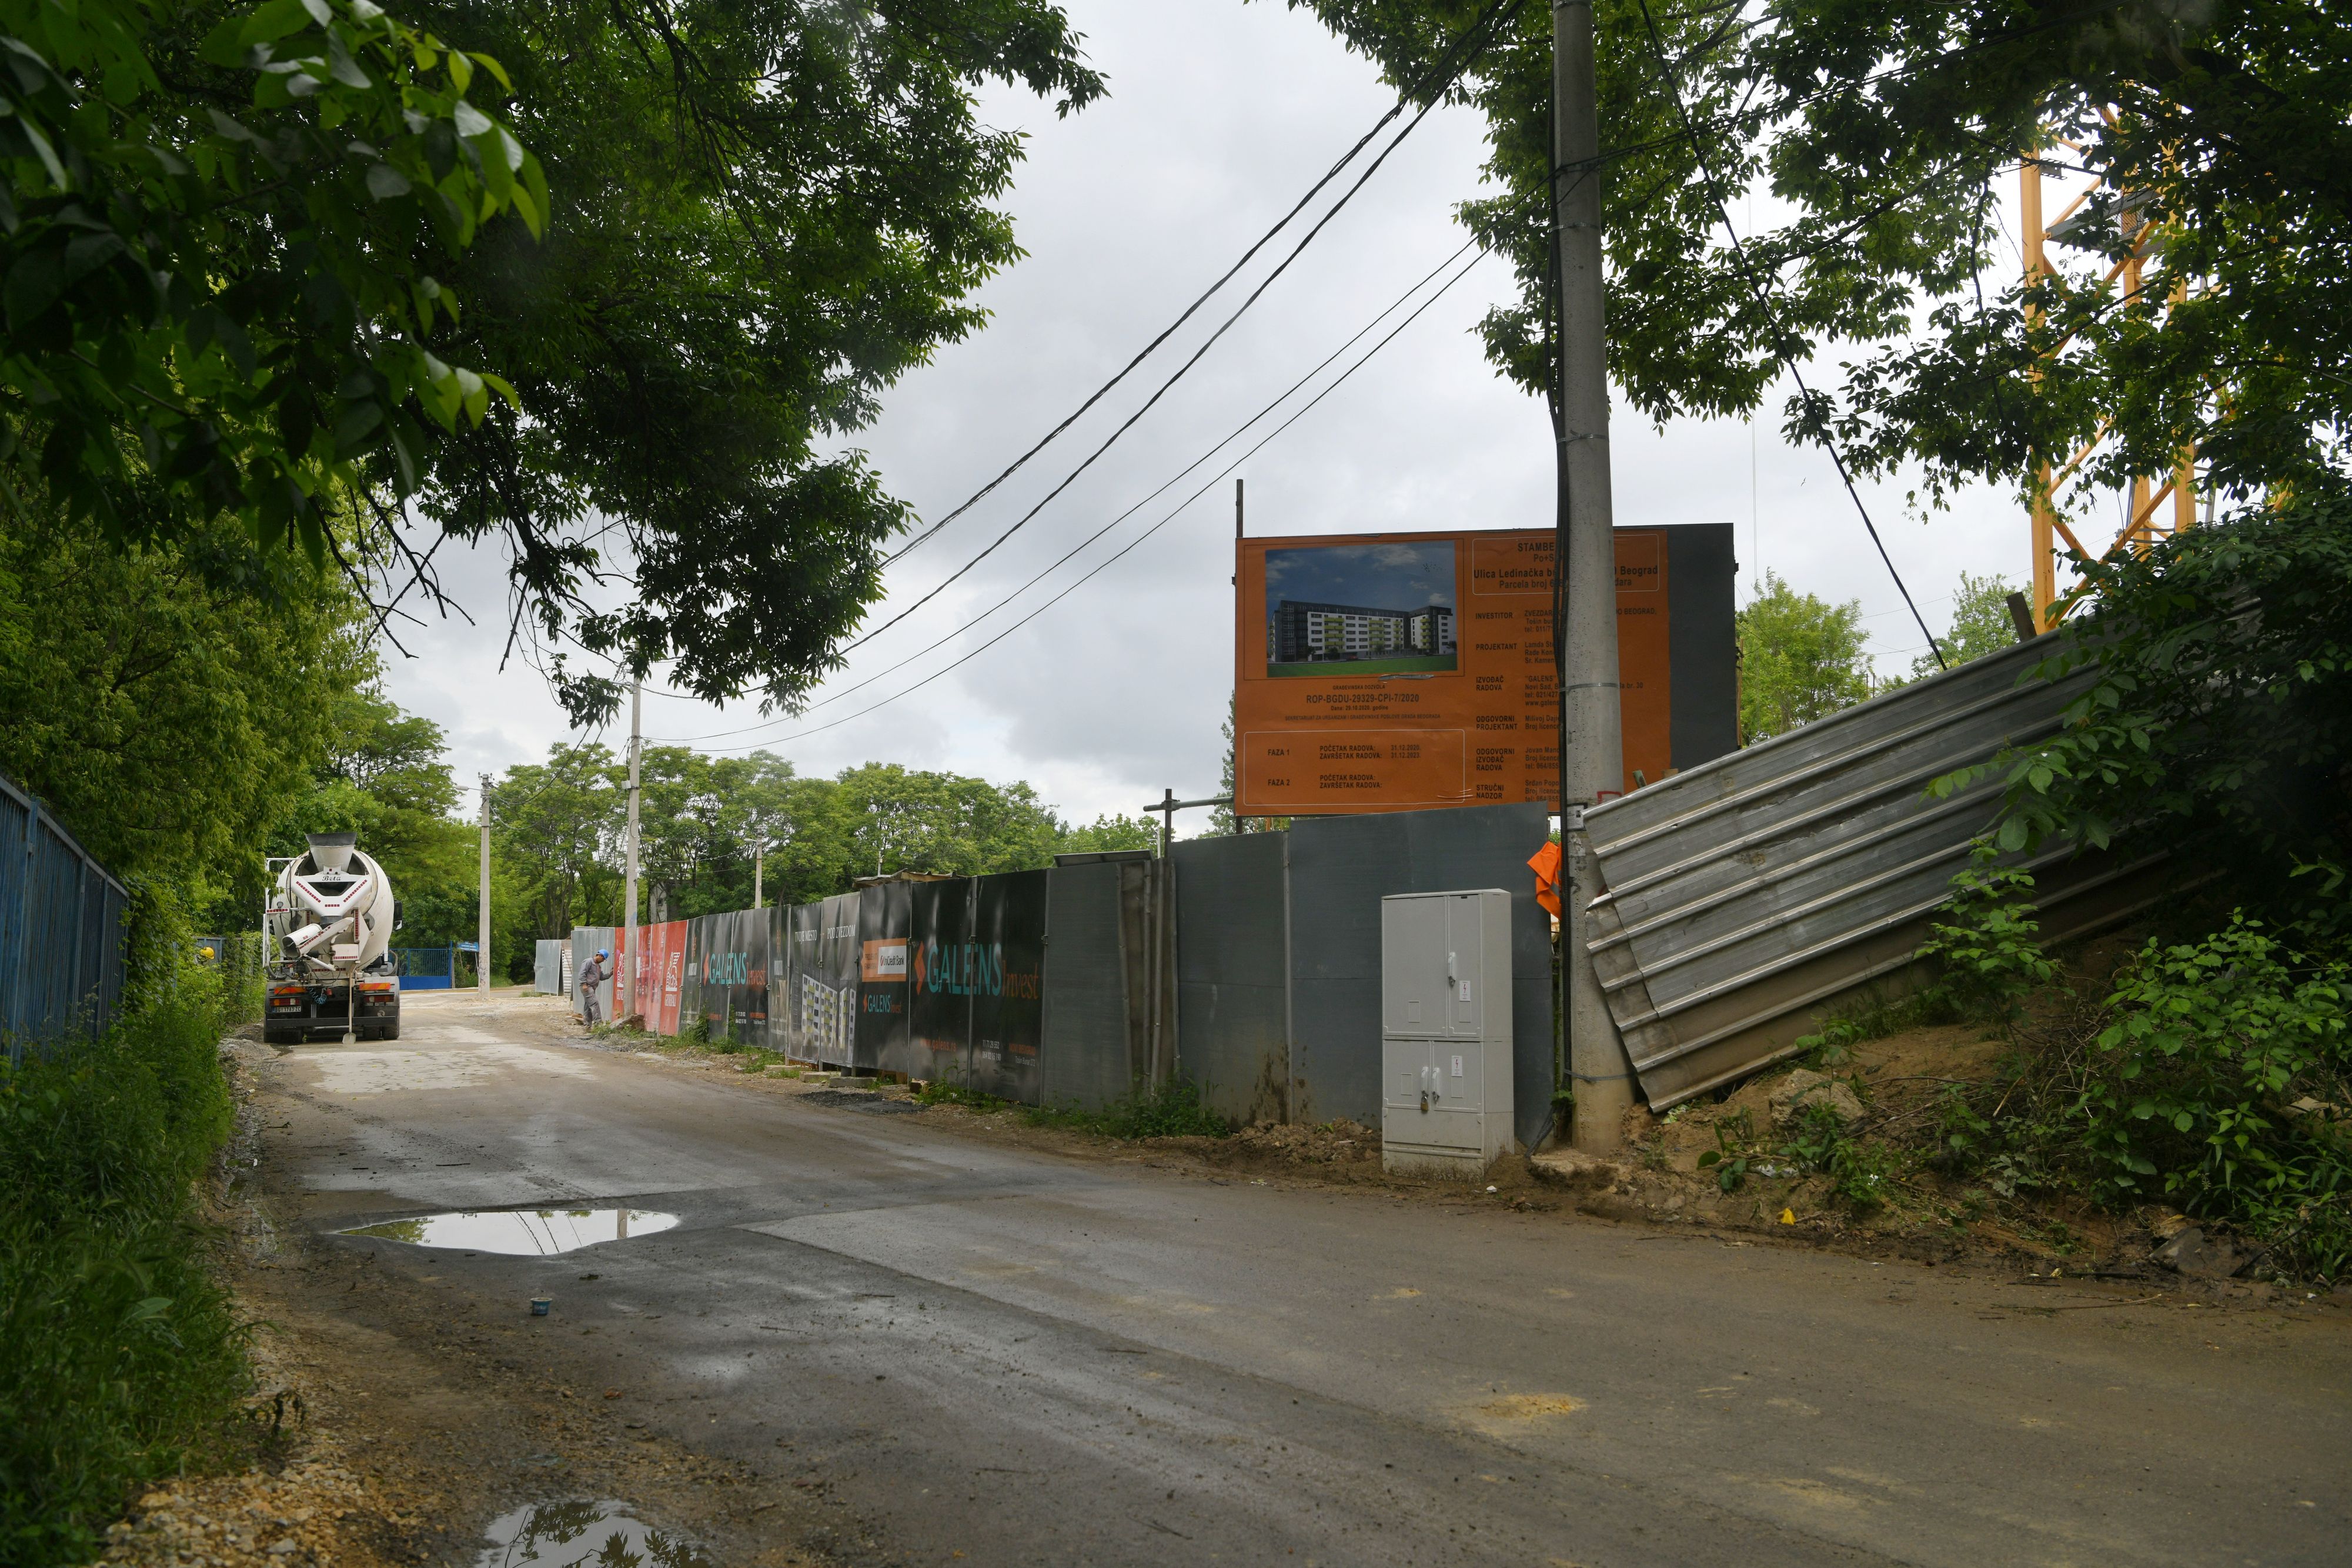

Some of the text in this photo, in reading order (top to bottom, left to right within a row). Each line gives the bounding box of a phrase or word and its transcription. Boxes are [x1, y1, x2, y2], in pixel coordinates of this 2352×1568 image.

[1518, 542, 1554, 551] STAMBE
[1534, 554, 1554, 562] Po+S
[1474, 569, 1495, 578] Ulica
[1499, 568, 1544, 578] Ledinačka
[1621, 565, 1658, 577] Beograd
[1499, 580, 1528, 589] Parcela
[1531, 579, 1546, 589] broj
[1615, 578, 1632, 586] dara
[1476, 675, 1504, 683] IZVOĐAČ
[1307, 694, 1419, 703] ROP-BGDU-29329-CPI-7/2020
[1525, 699, 1559, 707] www.galens
[1476, 783, 1504, 791] STRUČNI
[795, 930, 804, 945] TVOJE
[805, 929, 817, 942] MESTO
[827, 927, 836, 940] POD
[836, 924, 856, 938] ZVEZDOM
[883, 955, 904, 966] UniCredit Bank
[709, 952, 747, 985] GALENS
[927, 942, 1039, 1001] GALENS Invest
[867, 994, 890, 1013] GALENS
